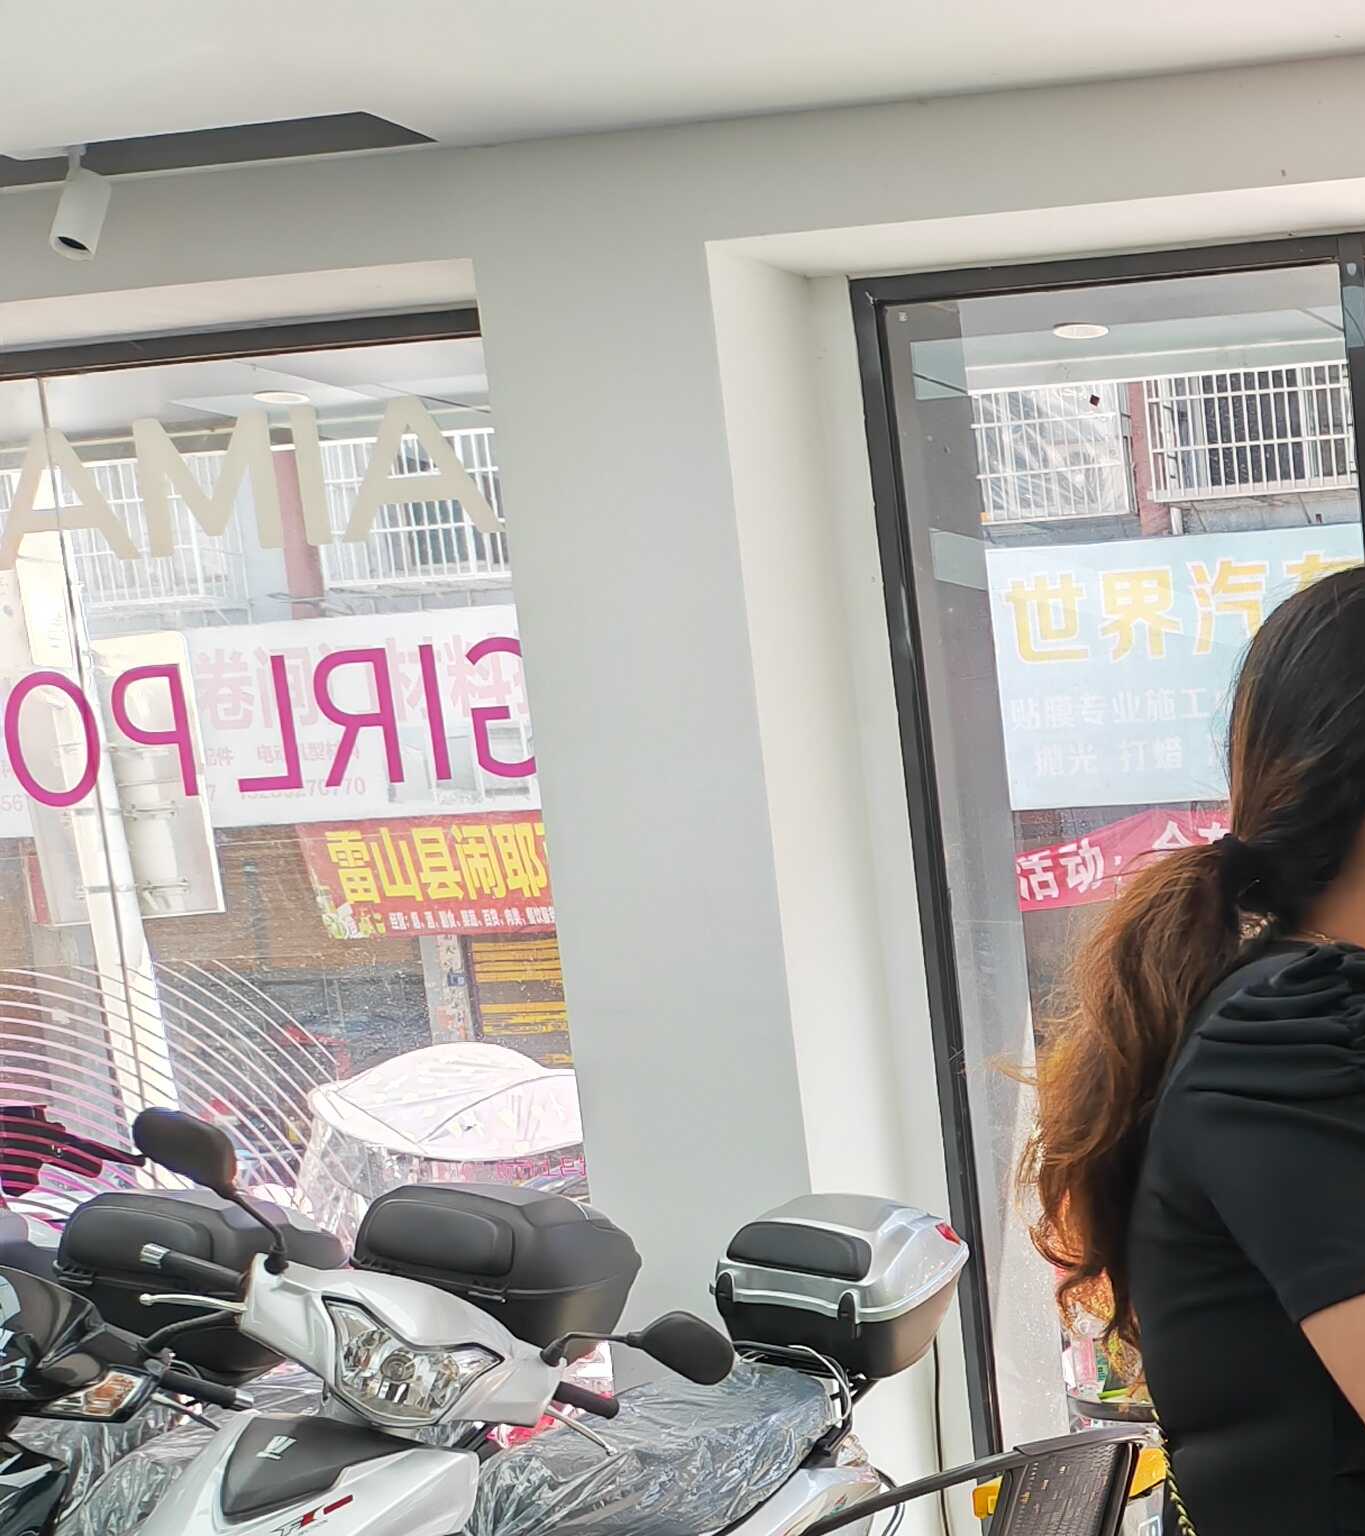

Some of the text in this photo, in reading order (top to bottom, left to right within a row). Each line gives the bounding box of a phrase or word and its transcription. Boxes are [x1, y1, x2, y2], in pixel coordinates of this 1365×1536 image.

[325, 823, 549, 904] 雷山县闹耶
